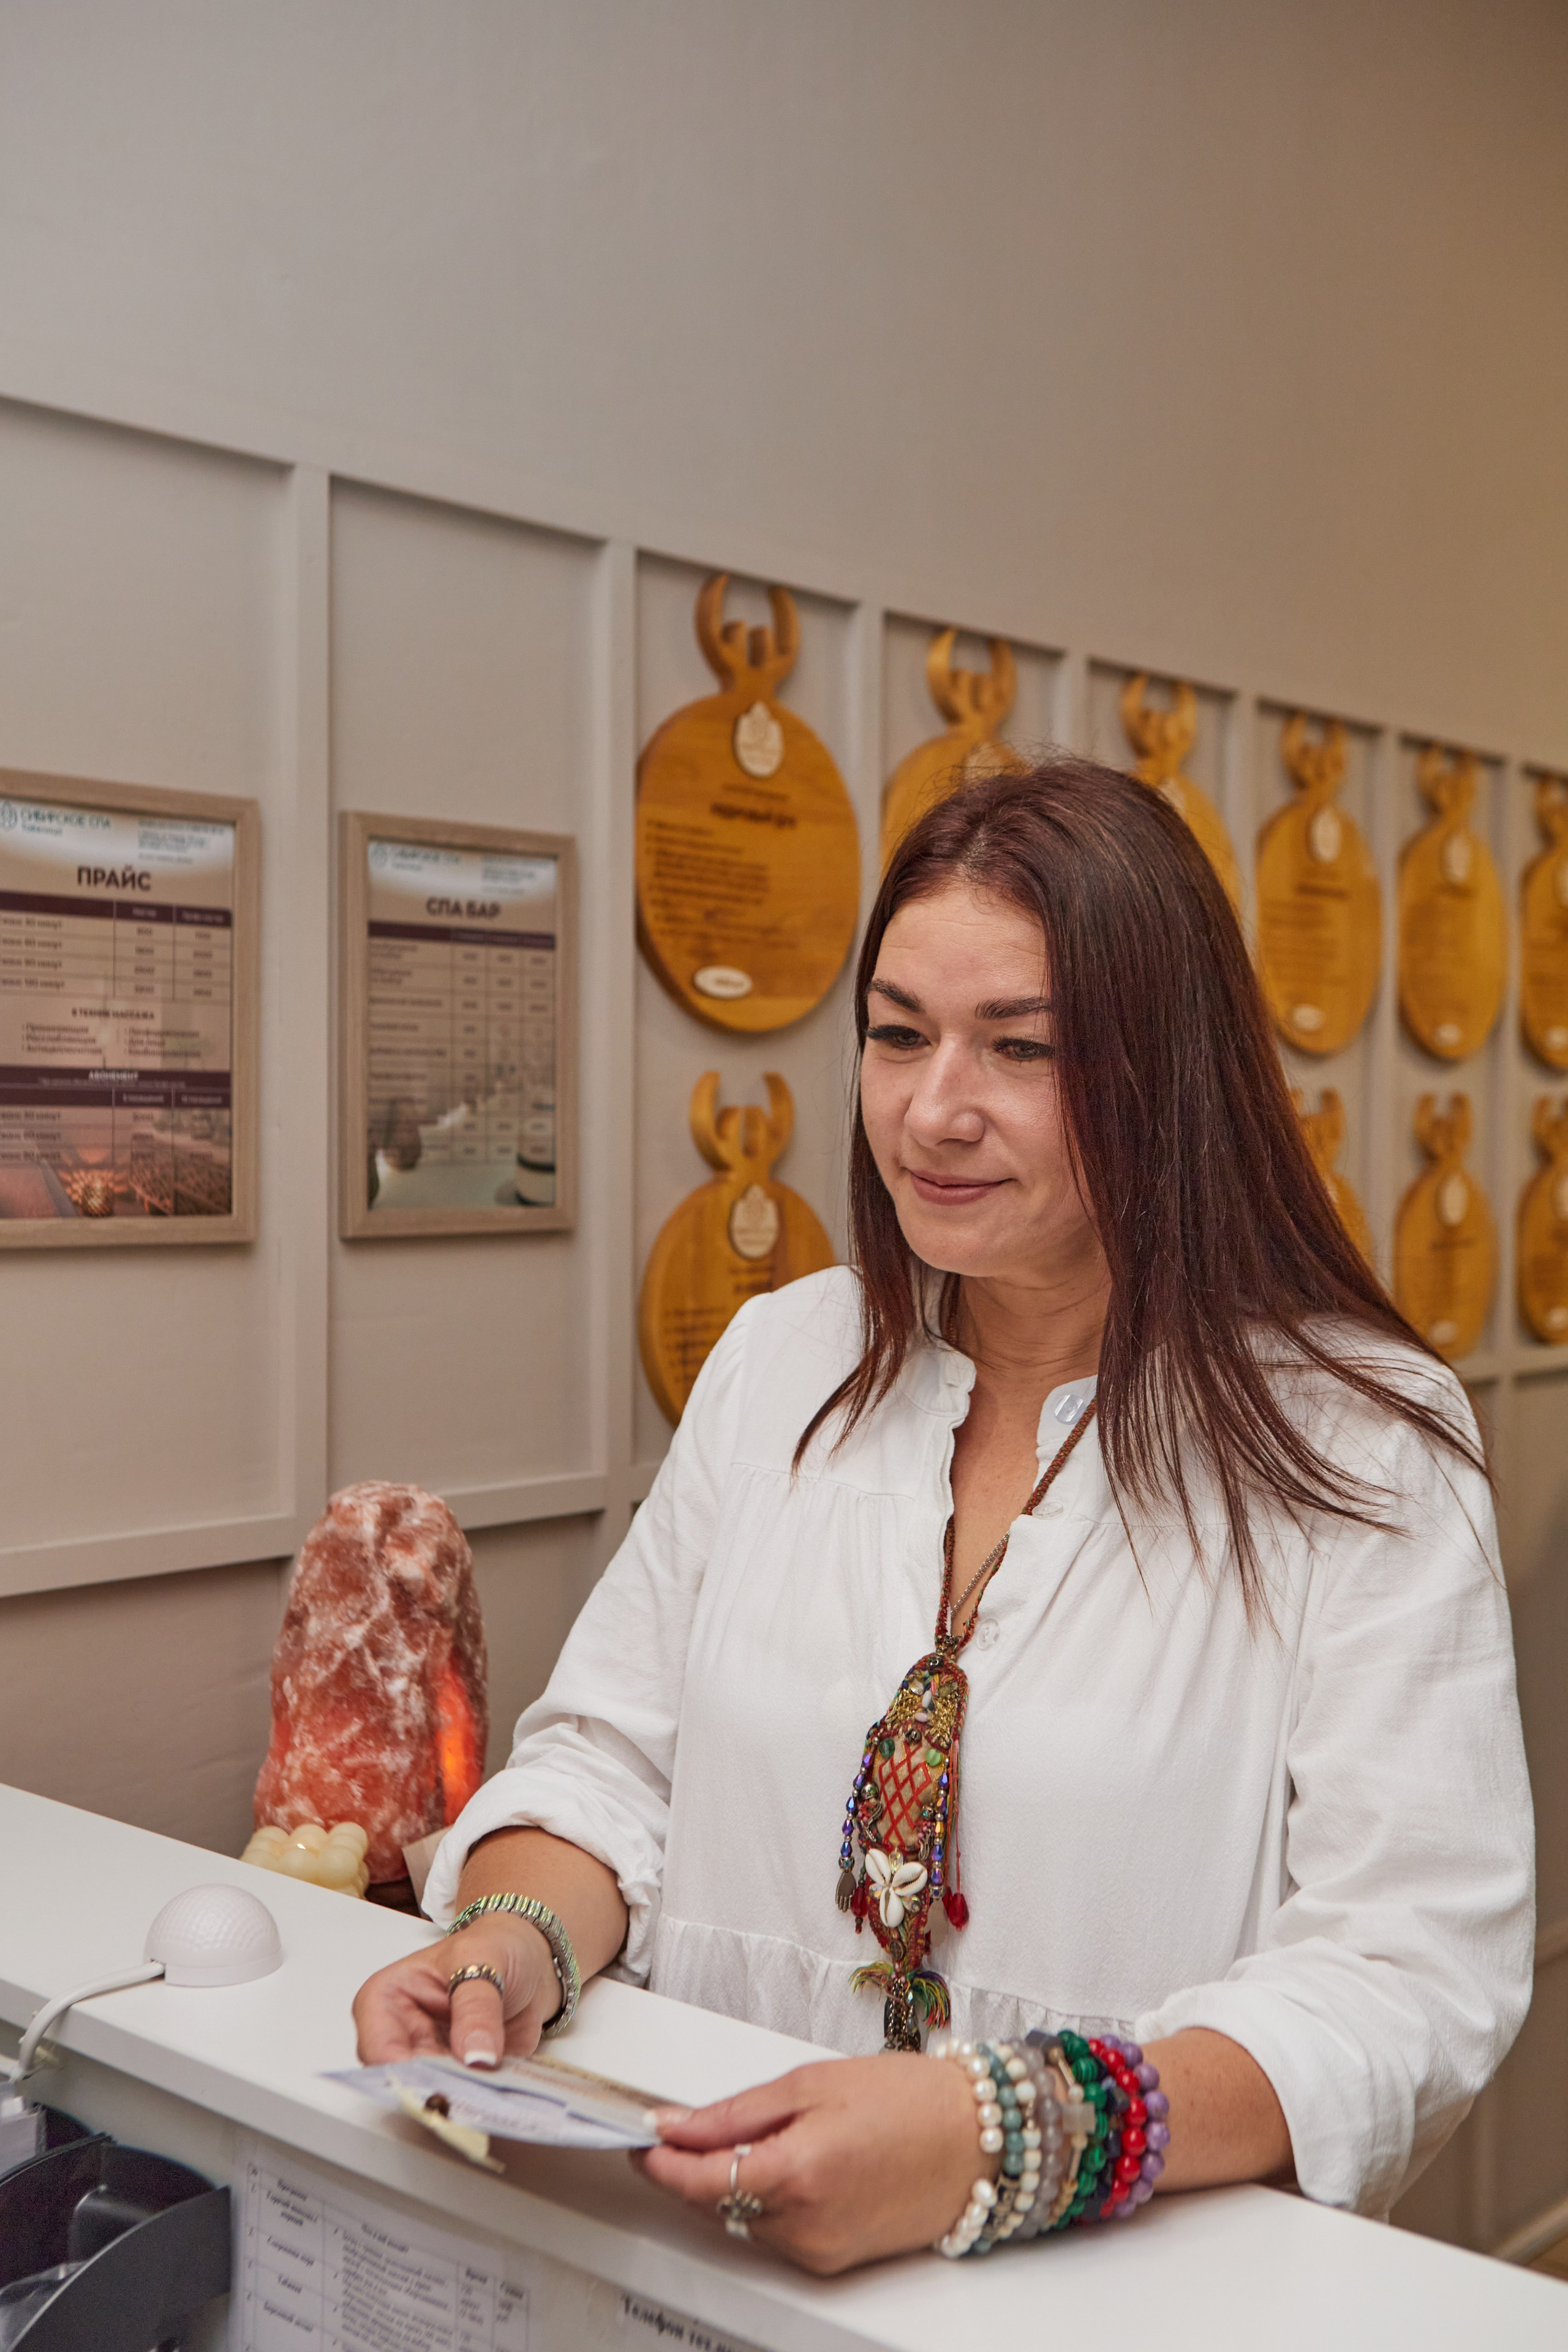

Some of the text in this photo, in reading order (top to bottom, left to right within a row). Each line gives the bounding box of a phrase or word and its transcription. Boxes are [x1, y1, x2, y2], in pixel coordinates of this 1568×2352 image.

[77, 864, 151, 891] ПРАЙС
[426, 897, 501, 918] СПА БАР
[620, 2294, 685, 2341] Телефон
